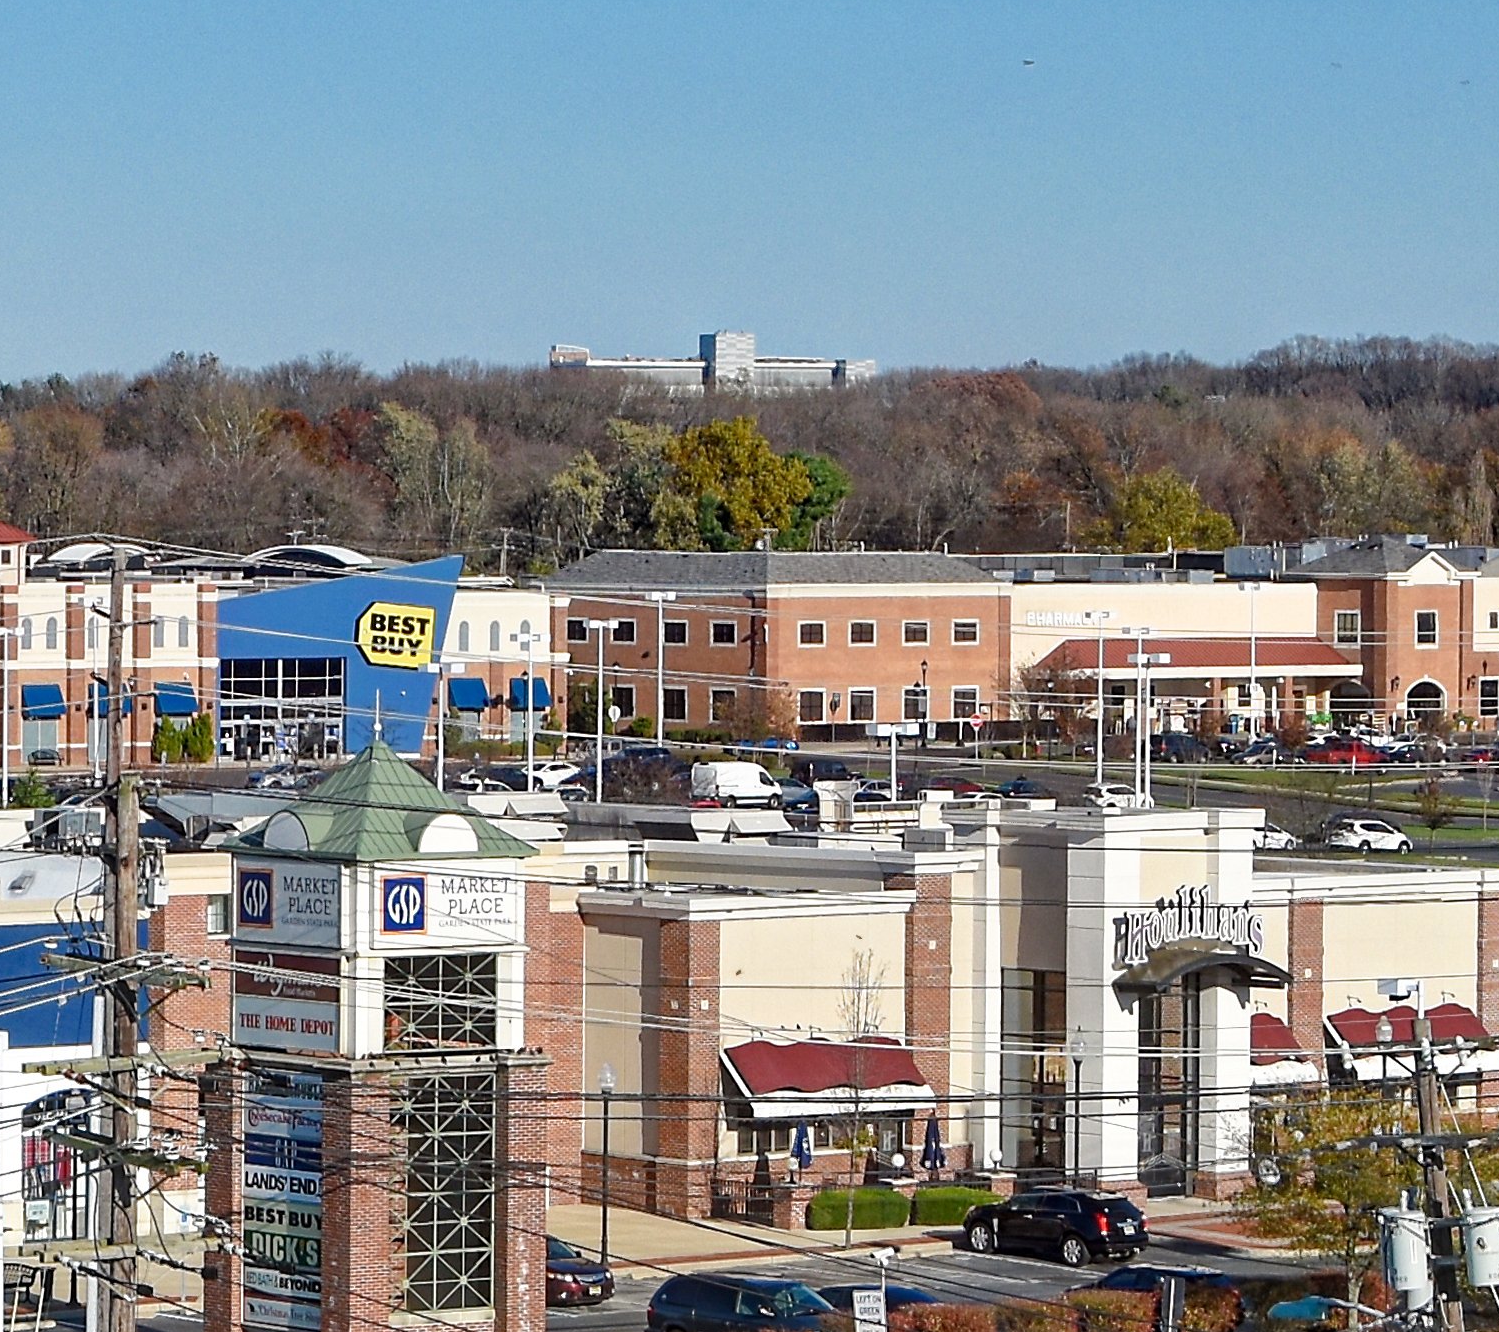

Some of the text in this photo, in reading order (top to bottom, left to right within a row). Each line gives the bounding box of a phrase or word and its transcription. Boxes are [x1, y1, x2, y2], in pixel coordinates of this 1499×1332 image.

[370, 613, 430, 636] BEST
[371, 635, 423, 657] BUY
[283, 876, 338, 895] MARKET
[441, 878, 511, 895] MARKET
[288, 897, 332, 916] PLACE
[449, 898, 504, 916] PLACE
[1123, 884, 1265, 967] Houlihan's
[239, 1013, 334, 1036] THE HOME DEPOT
[245, 1171, 318, 1196] LANDS' END
[245, 1205, 321, 1230] BEST BUY
[251, 1232, 318, 1266] DICK'S
[279, 1276, 321, 1293] BEYOND
